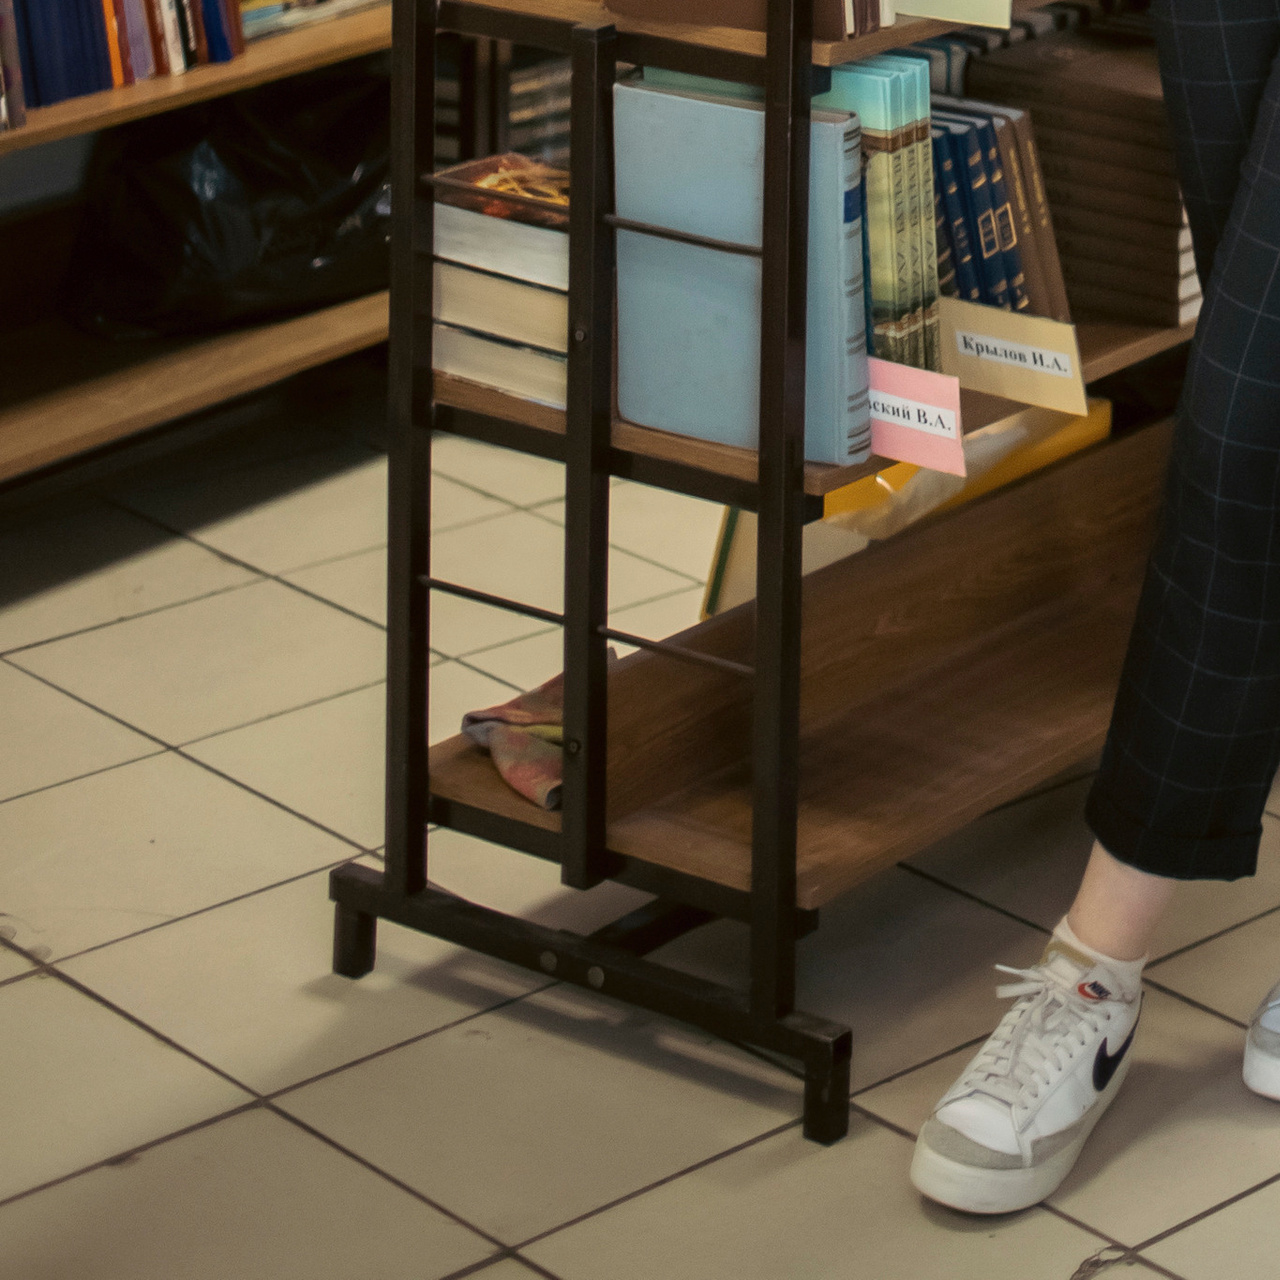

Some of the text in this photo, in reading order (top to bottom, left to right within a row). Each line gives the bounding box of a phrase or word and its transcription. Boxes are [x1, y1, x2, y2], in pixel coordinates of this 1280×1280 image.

[961, 334, 1069, 373] Крылов И.А.
[870, 400, 952, 431] ский В.А.
